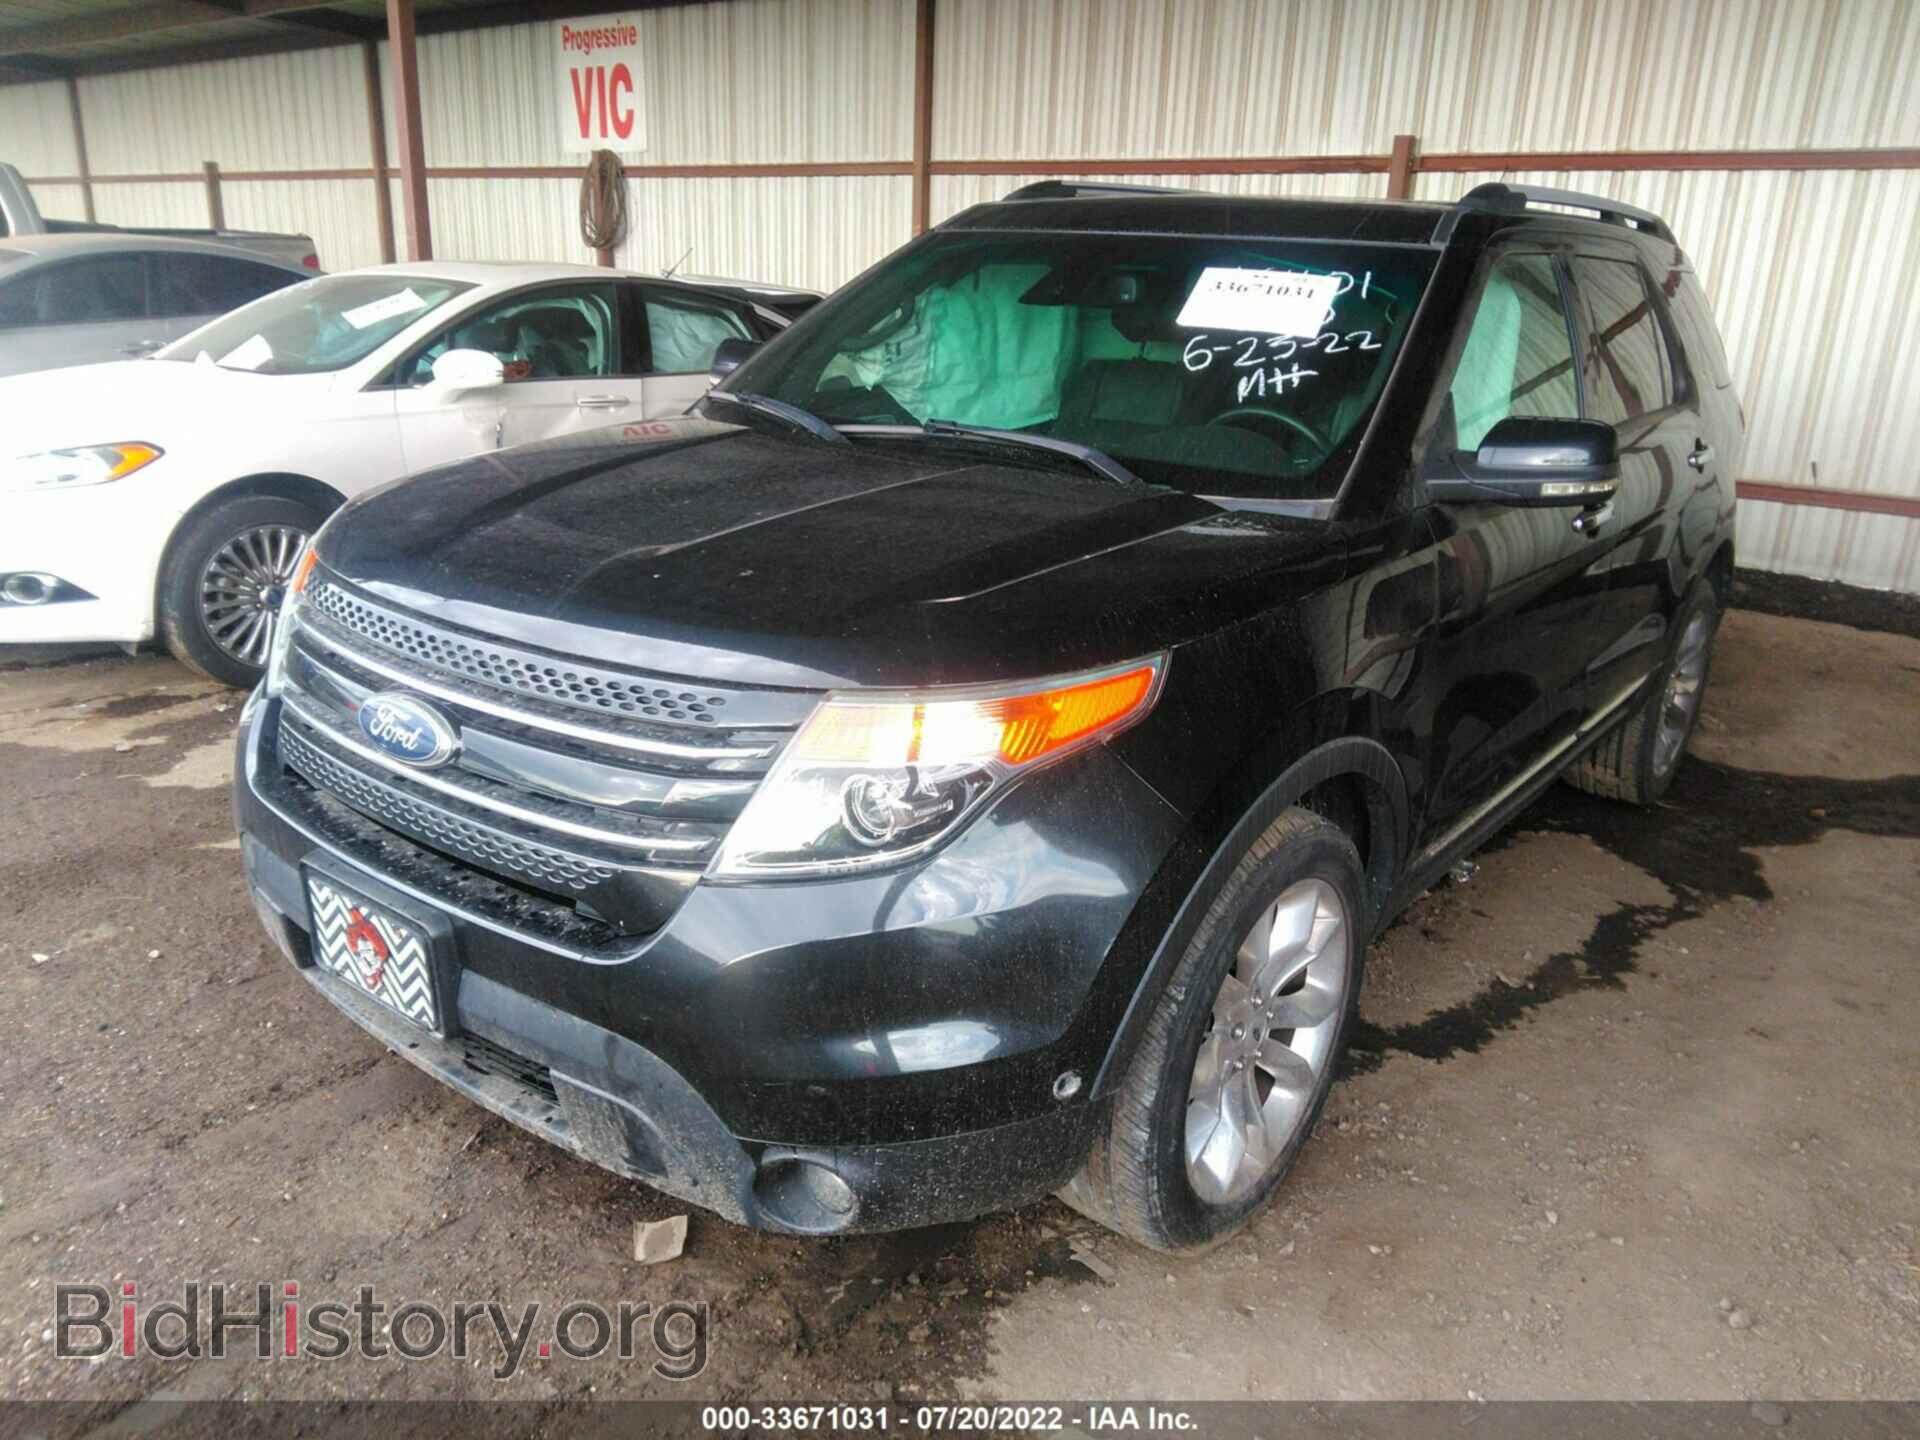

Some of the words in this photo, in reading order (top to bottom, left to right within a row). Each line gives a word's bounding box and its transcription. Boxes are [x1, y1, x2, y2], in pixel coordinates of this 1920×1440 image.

[561, 19, 638, 55] Progressive
[569, 62, 635, 140] VIC
[1183, 330, 1382, 372] 6-23-22
[369, 703, 424, 751] Ford
